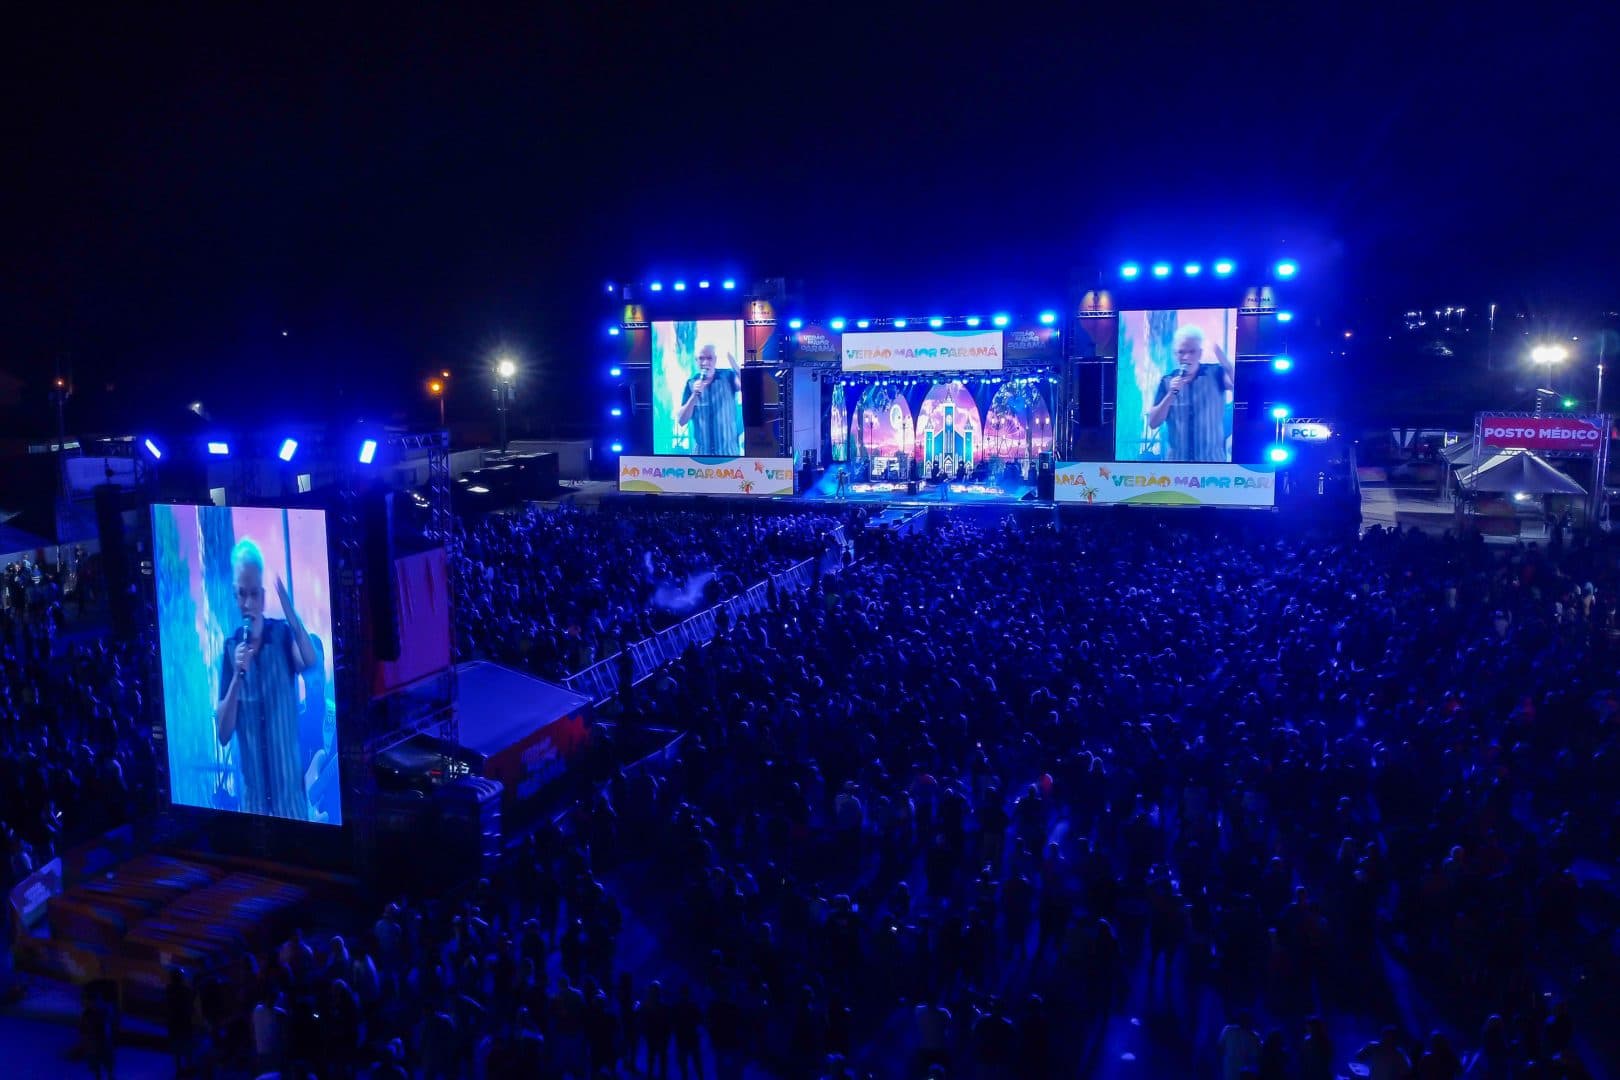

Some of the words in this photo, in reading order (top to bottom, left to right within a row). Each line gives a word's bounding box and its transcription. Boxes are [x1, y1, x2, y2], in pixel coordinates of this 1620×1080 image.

[895, 348, 938, 358] MAIOR
[940, 344, 998, 358] PARANÁ
[1484, 427, 1536, 438] POSTO
[1538, 426, 1599, 440] MÉDICO
[641, 467, 685, 478] MAIOR
[687, 466, 745, 480] PARANÁ
[1112, 473, 1171, 488] VERÃO
[1173, 476, 1232, 488] MAIOR
